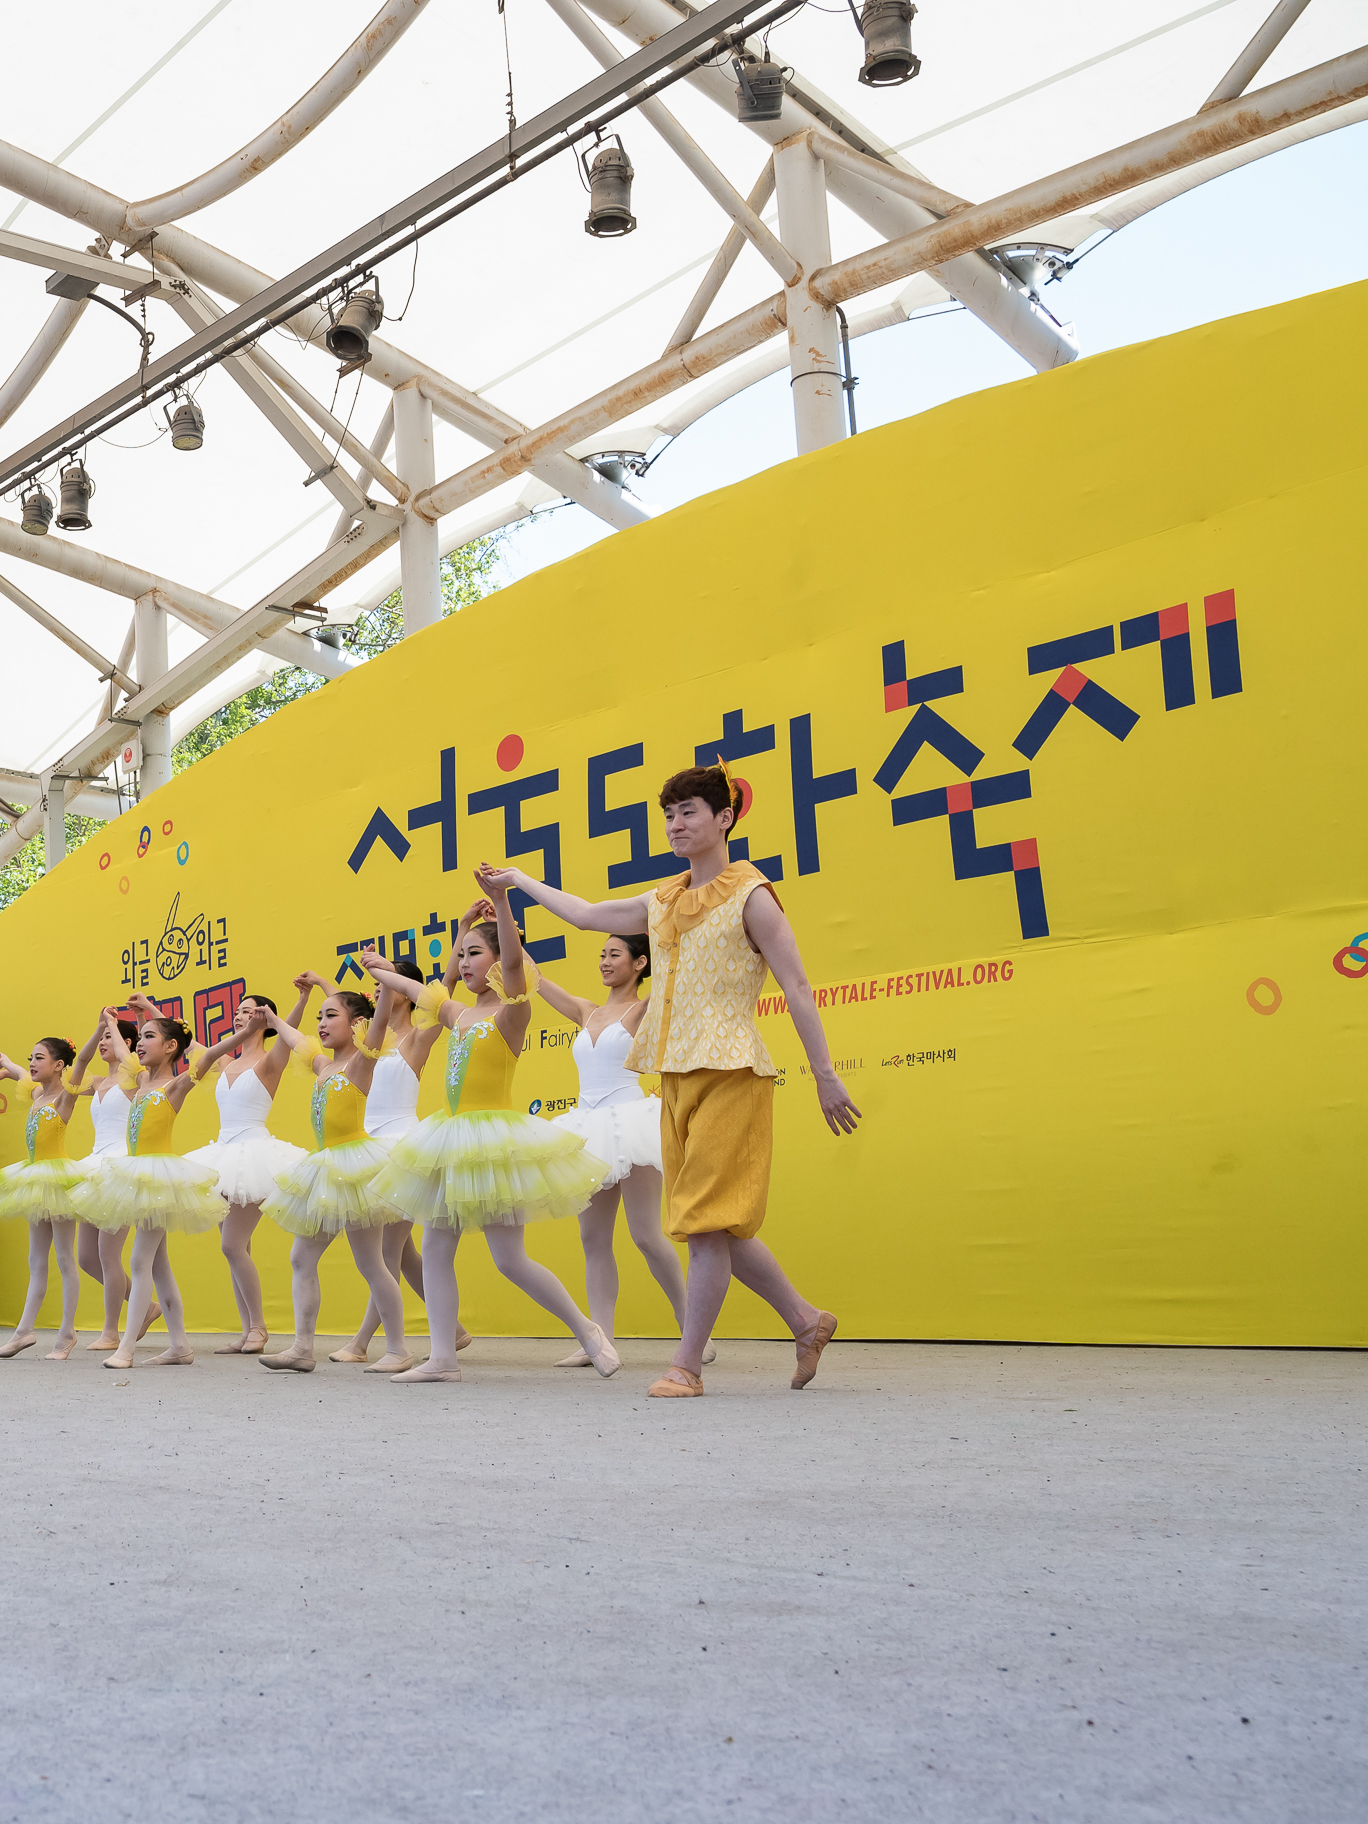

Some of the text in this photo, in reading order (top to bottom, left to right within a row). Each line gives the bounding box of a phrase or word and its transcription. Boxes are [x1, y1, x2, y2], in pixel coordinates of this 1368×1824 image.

[121, 917, 229, 989] 와글 와글
[756, 959, 1014, 1018] WW.IRYTALE-FESTIVAL.ORG
[540, 1026, 580, 1049] Fairyt
[799, 1057, 867, 1076] WRHILL
[906, 1047, 956, 1067] 한국마사회
[545, 1097, 577, 1112] 광진구
